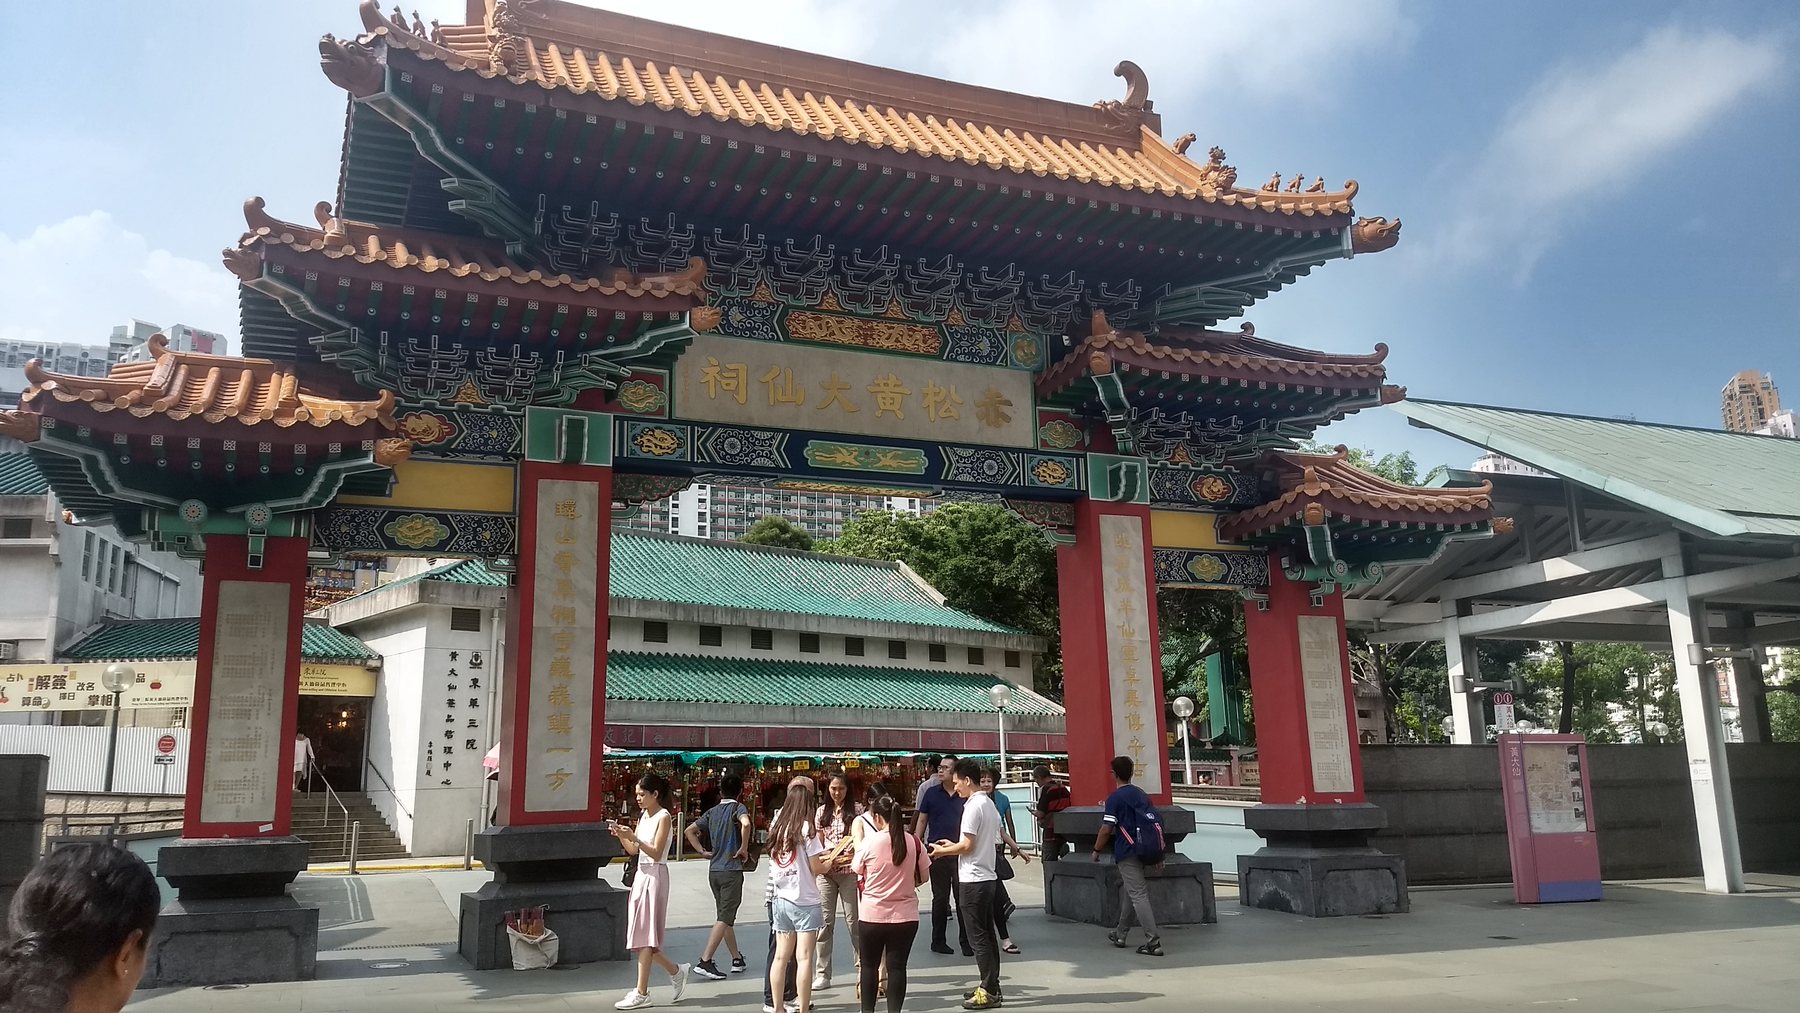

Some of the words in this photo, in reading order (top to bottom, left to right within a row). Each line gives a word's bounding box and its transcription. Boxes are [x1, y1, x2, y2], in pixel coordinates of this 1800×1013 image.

[6, 673, 24, 683] 占卜
[76, 682, 96, 692] 改名
[21, 696, 43, 708] 算命
[1510, 746, 1521, 777] 黃大仙
